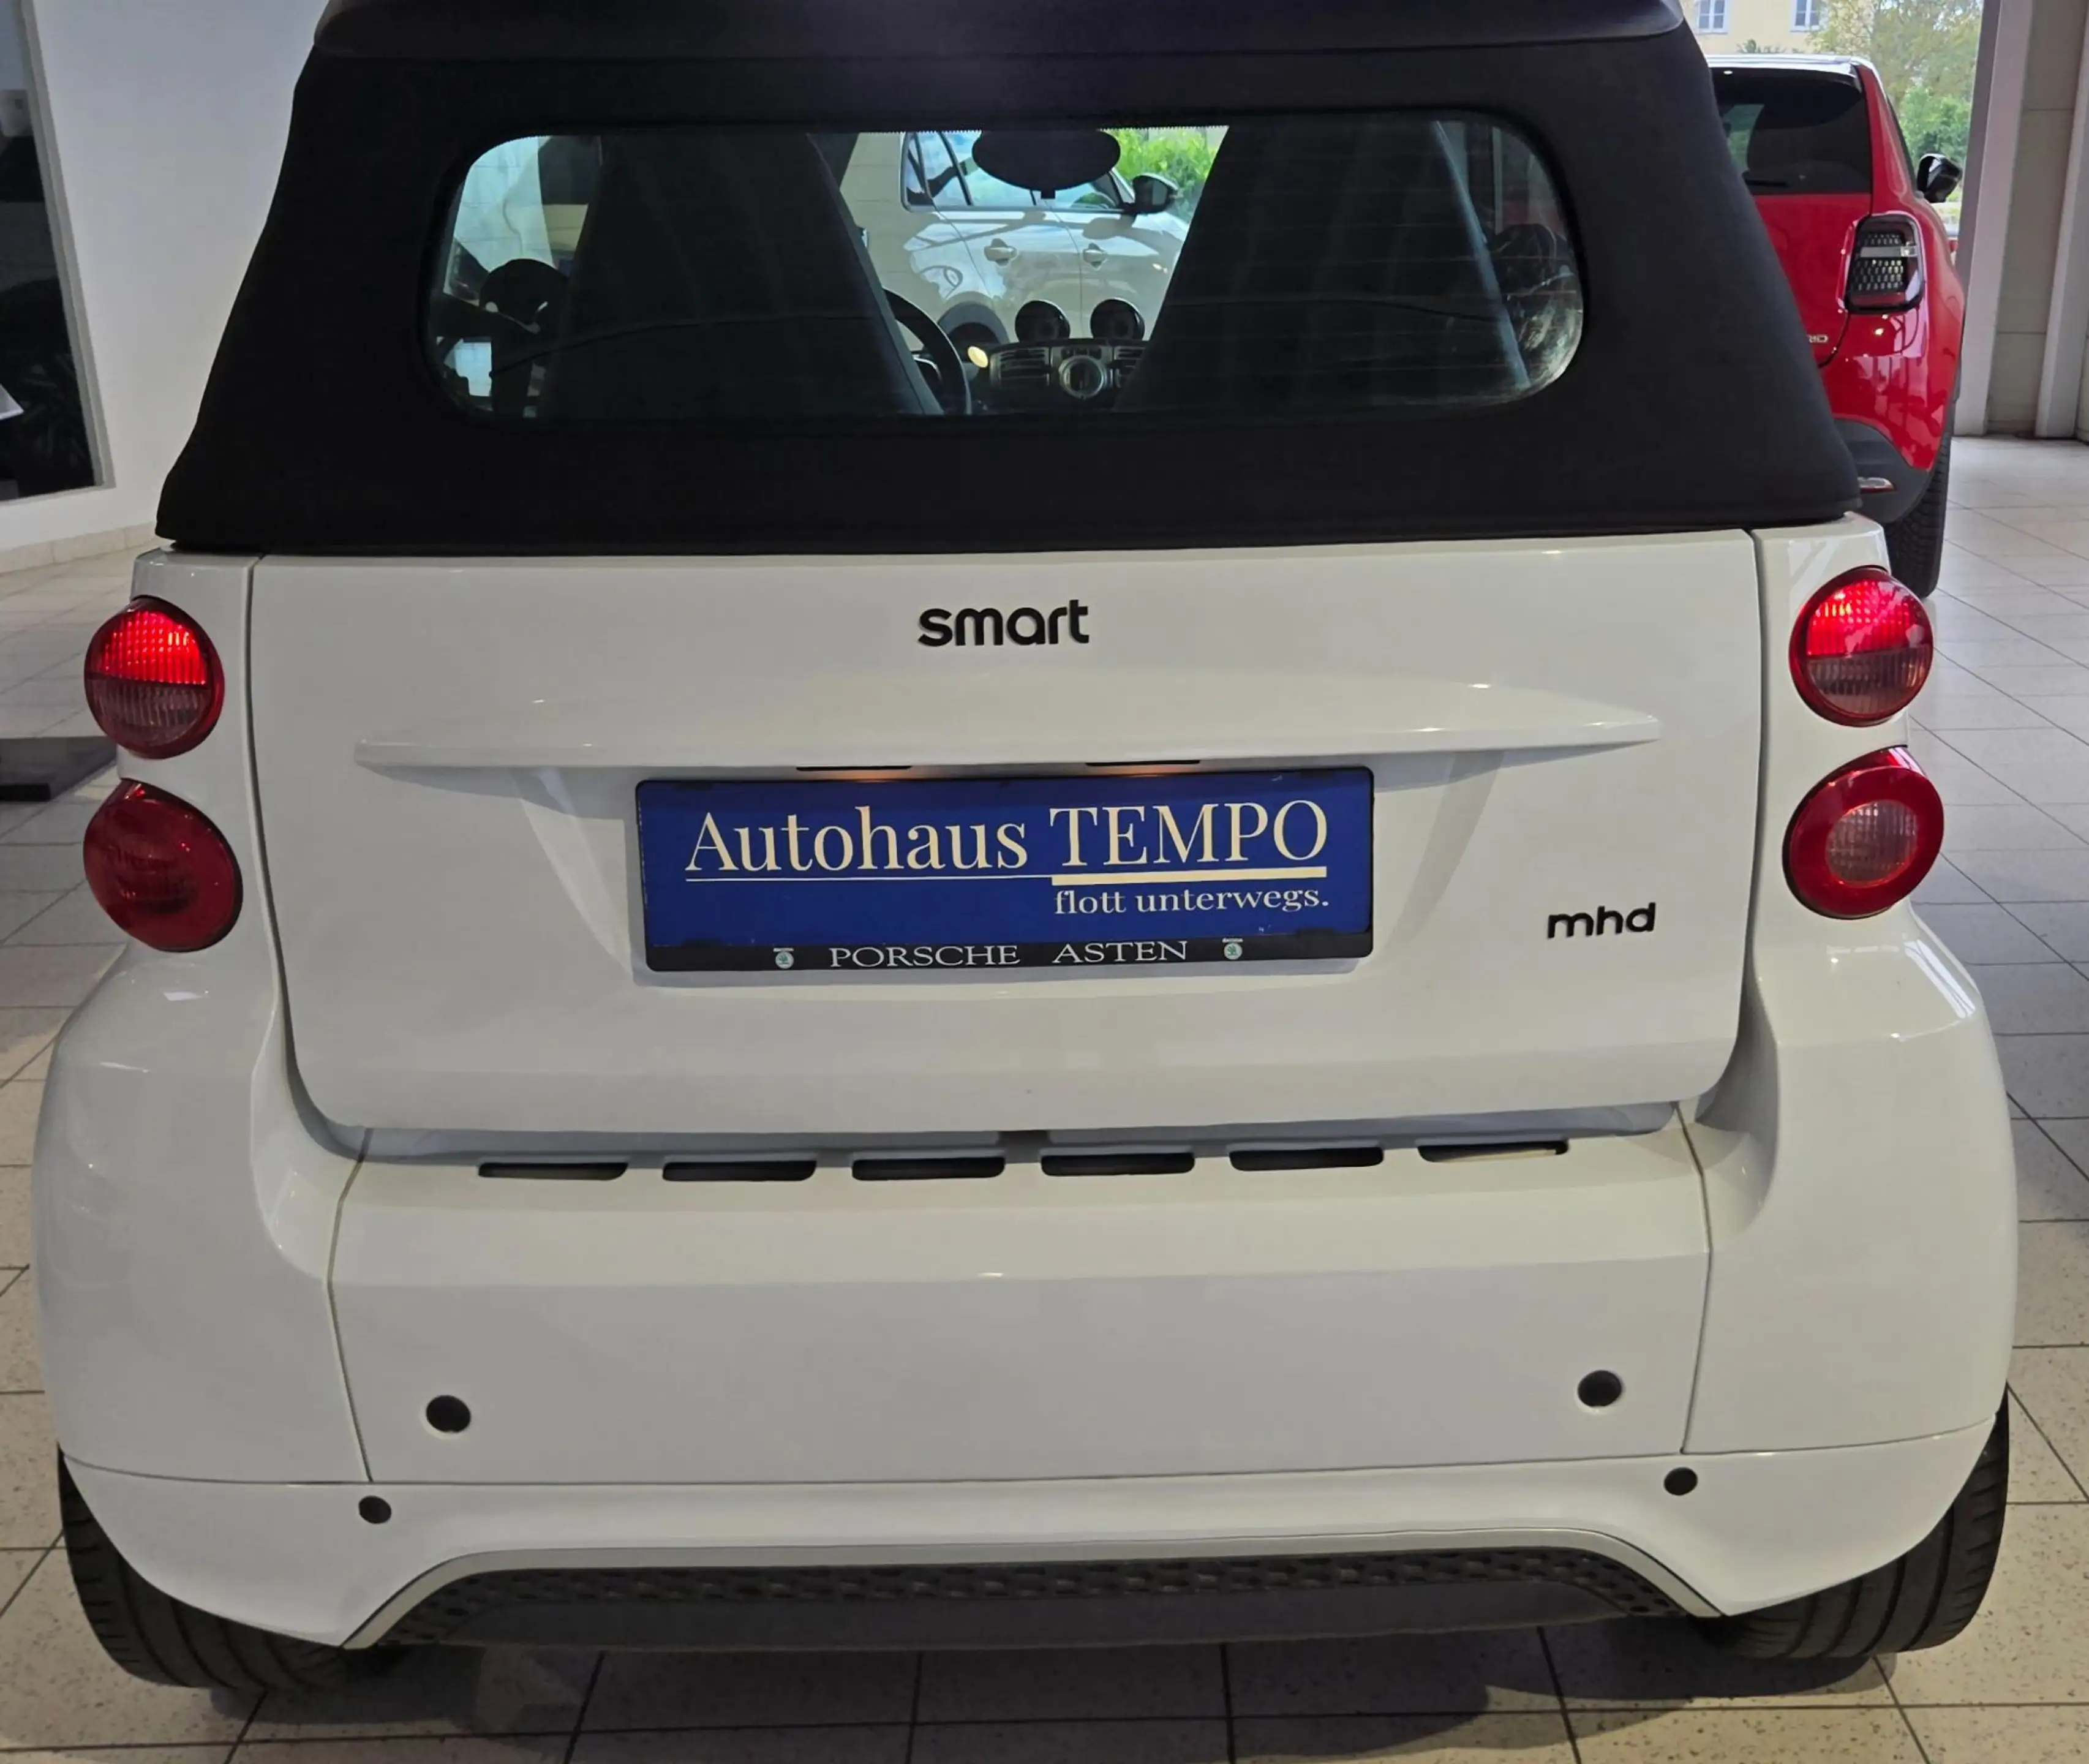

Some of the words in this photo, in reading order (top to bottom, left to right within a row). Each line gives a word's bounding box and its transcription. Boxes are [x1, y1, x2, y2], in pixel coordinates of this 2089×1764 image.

[917, 598, 1090, 647] smart
[685, 805, 1028, 872] Autohaus
[1049, 800, 1327, 866] TEMPO
[1055, 890, 1126, 914] flott
[1135, 888, 1330, 913] unterwegs.
[1547, 902, 1657, 940] mhd
[829, 945, 1021, 968] PORSCHE
[1052, 940, 1188, 963] ASTEN
